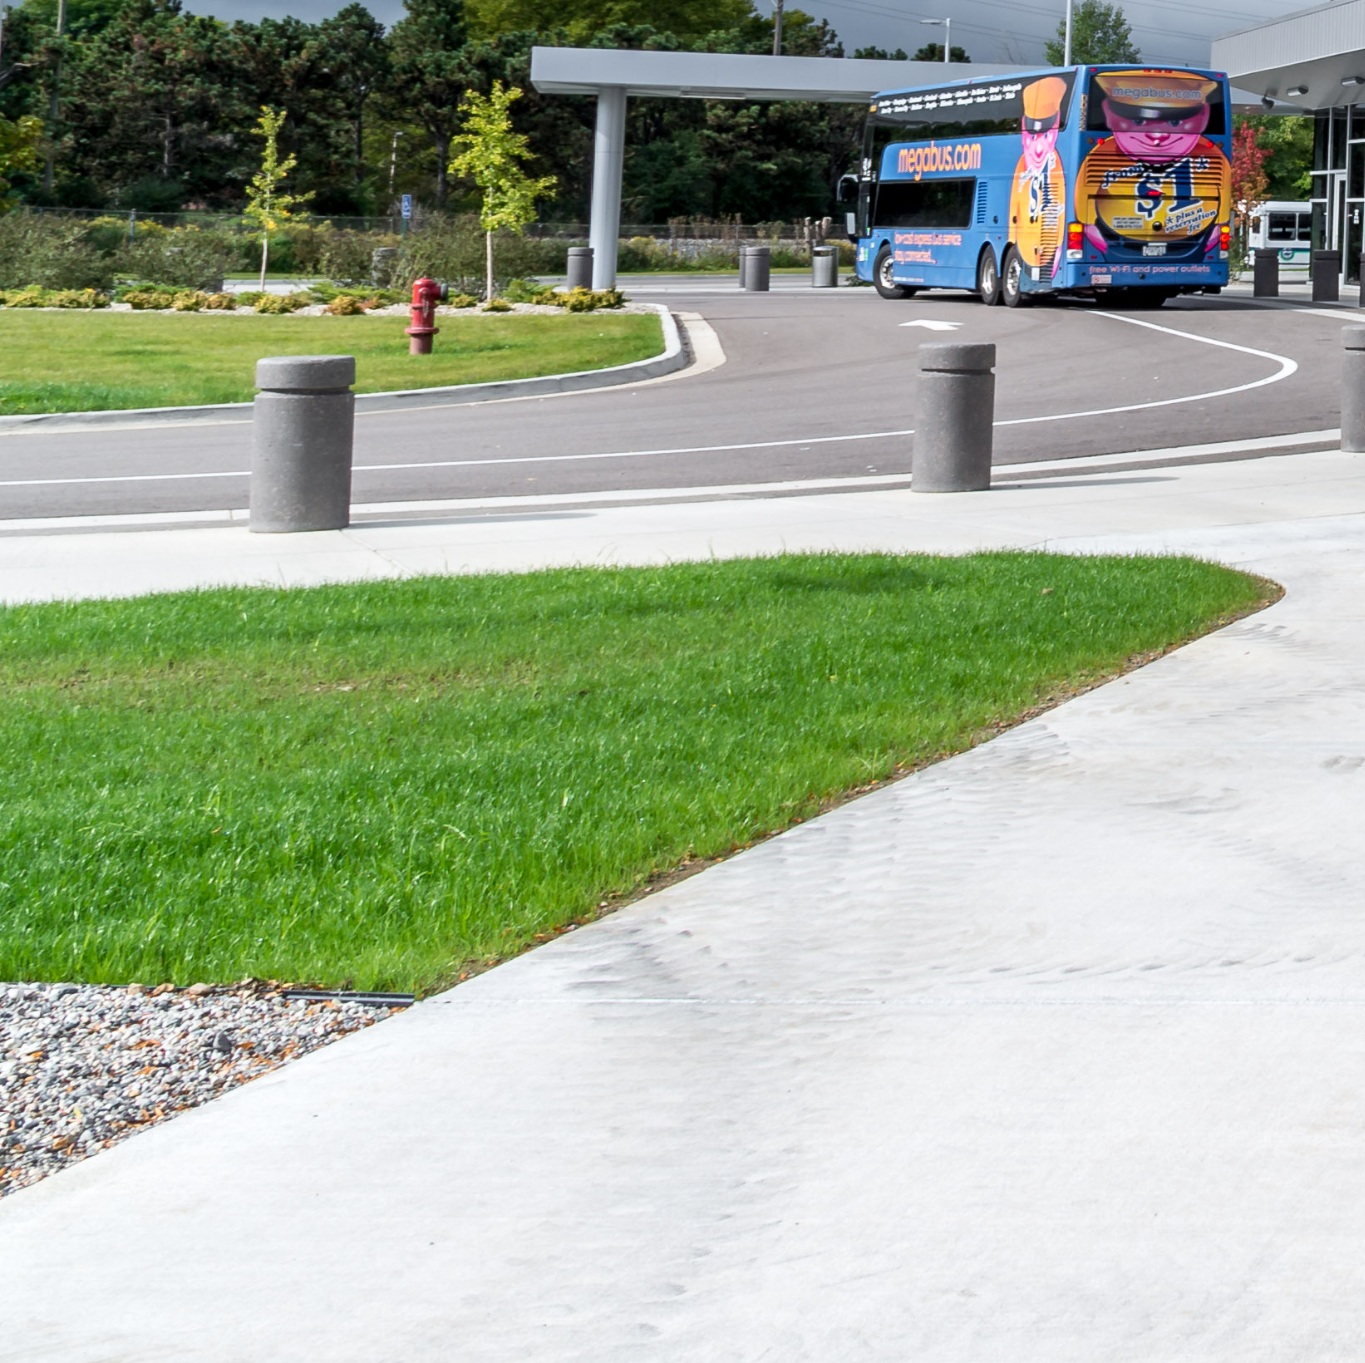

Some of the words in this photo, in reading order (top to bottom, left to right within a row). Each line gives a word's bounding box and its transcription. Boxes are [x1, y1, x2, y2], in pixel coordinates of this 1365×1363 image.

[1112, 86, 1202, 100] megabus.com
[897, 140, 982, 181] megabus.com
[1165, 210, 1217, 233] reservation
[1175, 210, 1195, 224] plus
[1187, 222, 1202, 235] fee
[1089, 265, 1107, 274] free
[1132, 265, 1151, 273] and
[1152, 265, 1179, 274] power
[1180, 265, 1211, 273] outlets
